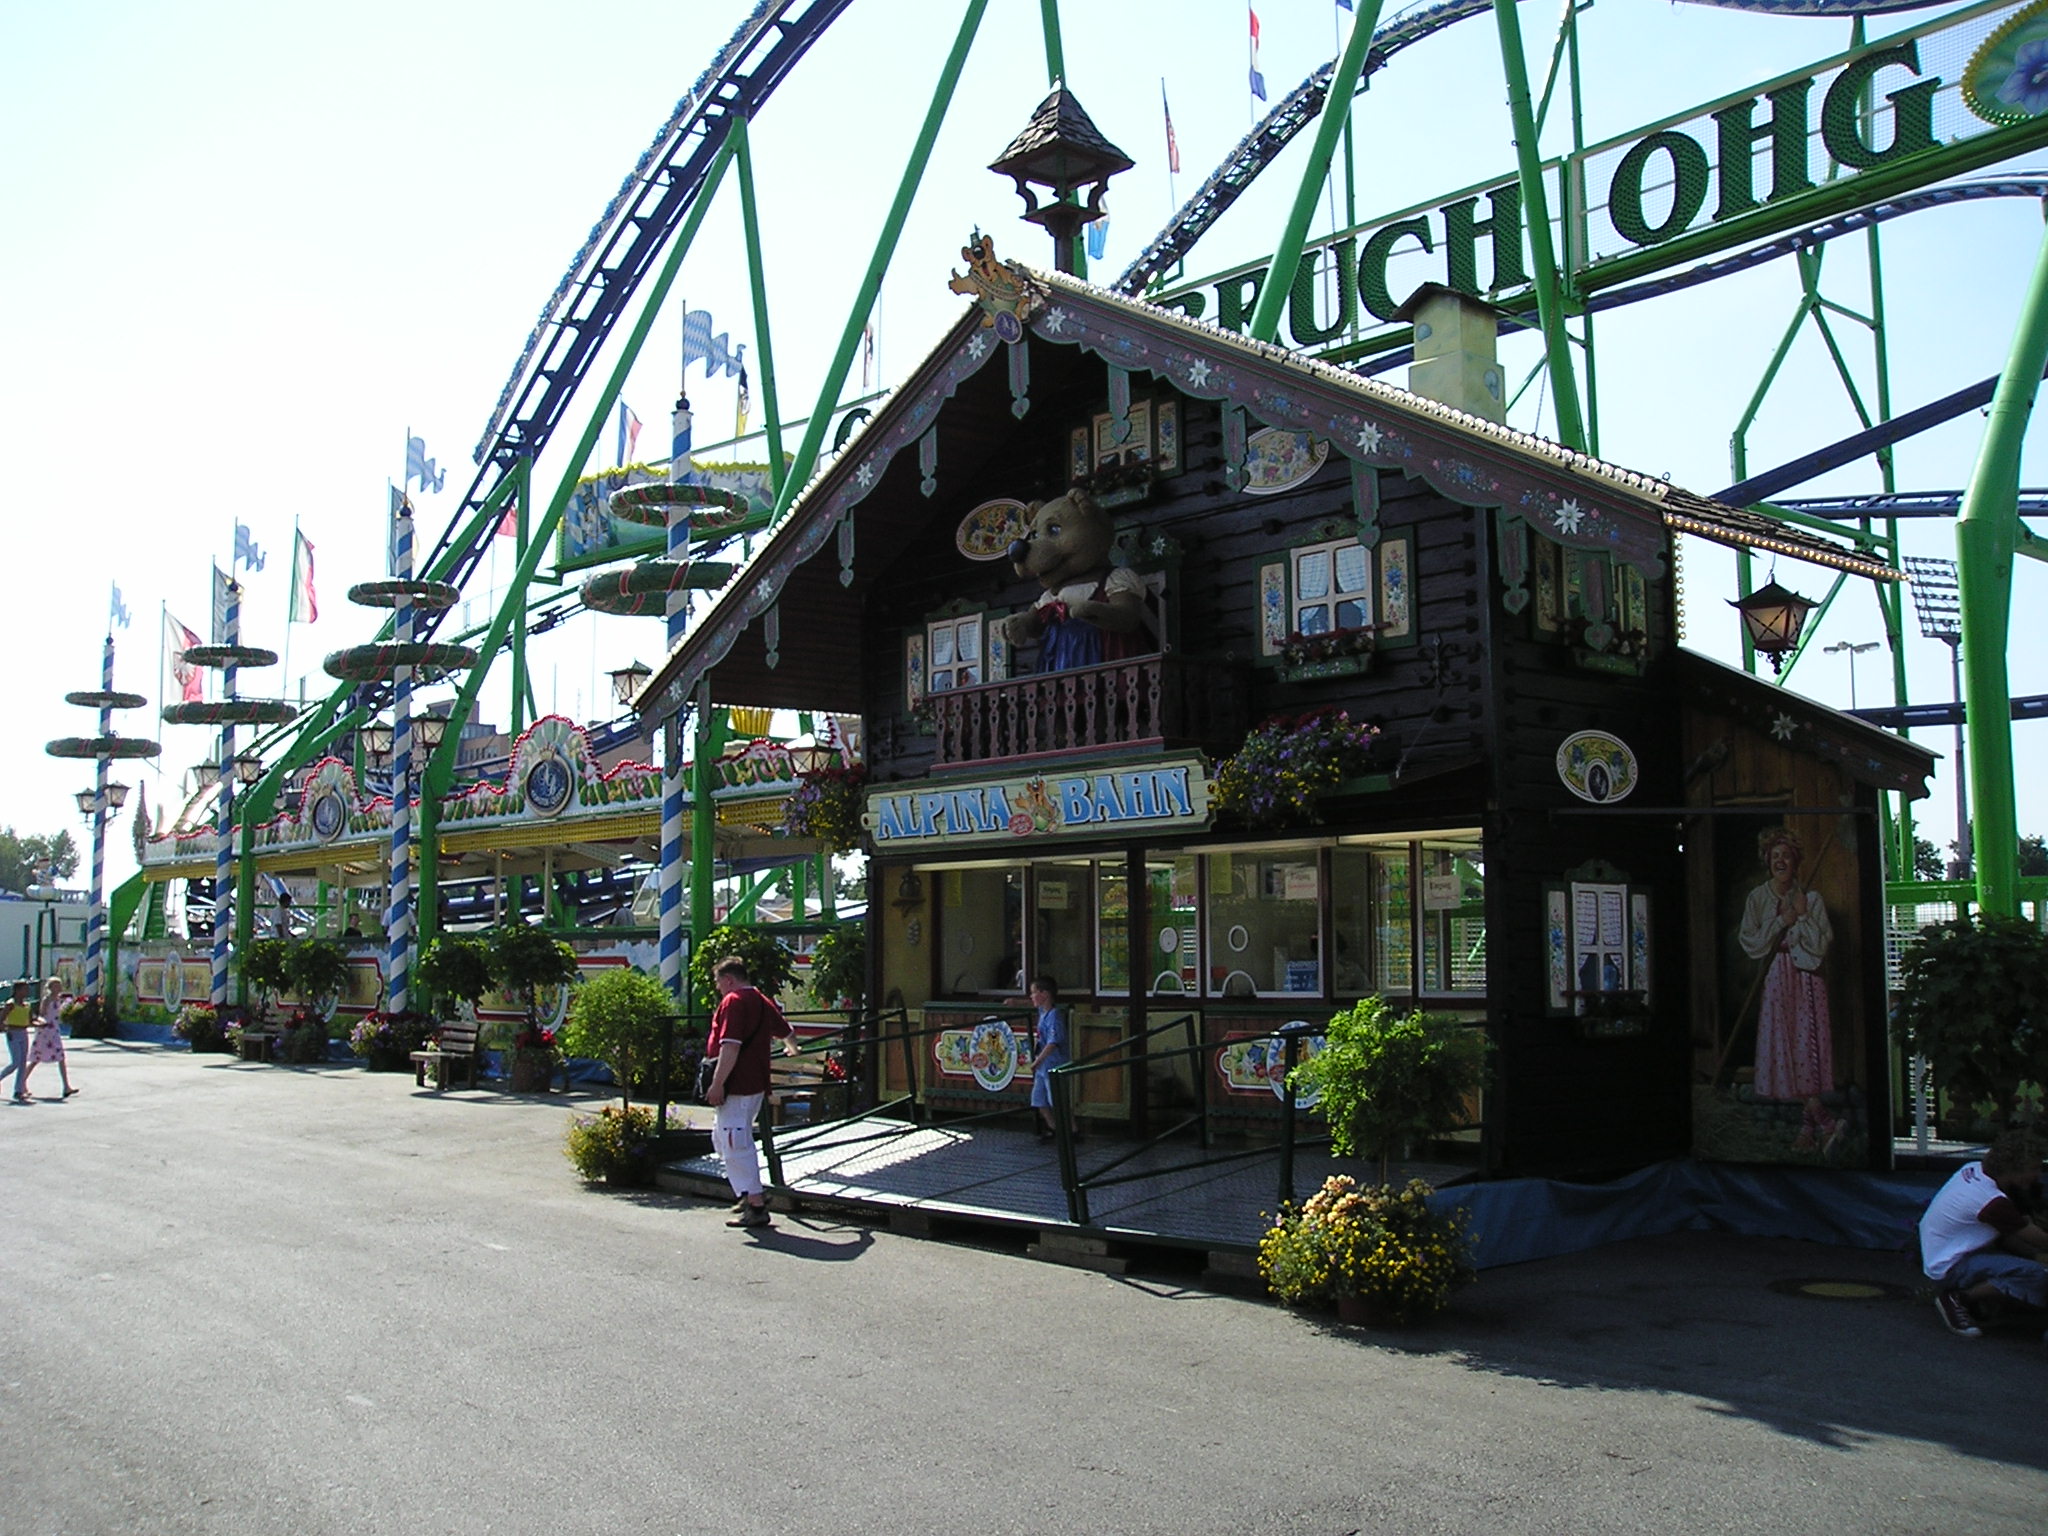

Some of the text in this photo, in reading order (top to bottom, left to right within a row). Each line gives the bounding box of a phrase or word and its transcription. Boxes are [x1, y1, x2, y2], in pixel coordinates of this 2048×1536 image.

[1608, 38, 1943, 247] OHG
[877, 767, 1194, 839] ALPINA BAHN
